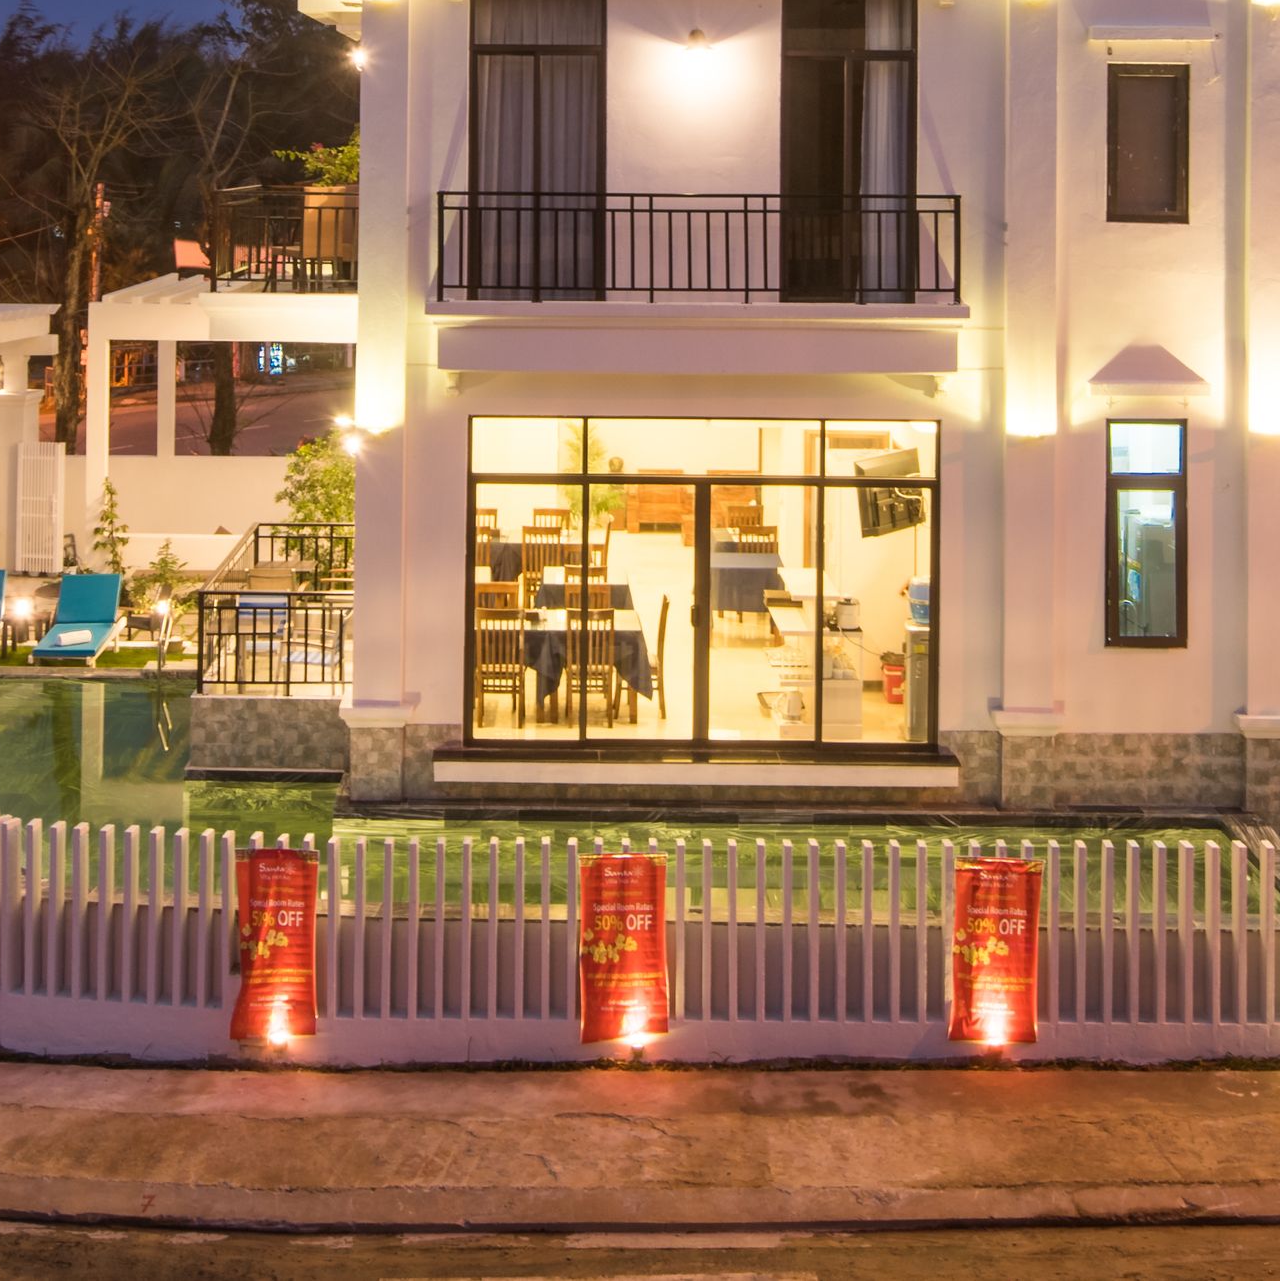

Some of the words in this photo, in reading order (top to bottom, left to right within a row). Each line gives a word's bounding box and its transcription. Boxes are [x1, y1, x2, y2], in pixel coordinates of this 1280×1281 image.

[269, 899, 287, 907] Room
[287, 899, 305, 908] Rates
[593, 903, 616, 912] Special
[617, 903, 635, 911] Room
[635, 903, 654, 911] Rates
[967, 905, 990, 915] Special
[990, 906, 1009, 915] Room
[1009, 907, 1028, 916] Rates
[277, 909, 304, 927] OFF
[594, 915, 624, 931] 50%
[626, 914, 652, 931] OFF
[967, 917, 996, 934] 50%
[999, 918, 1027, 935] OFF
